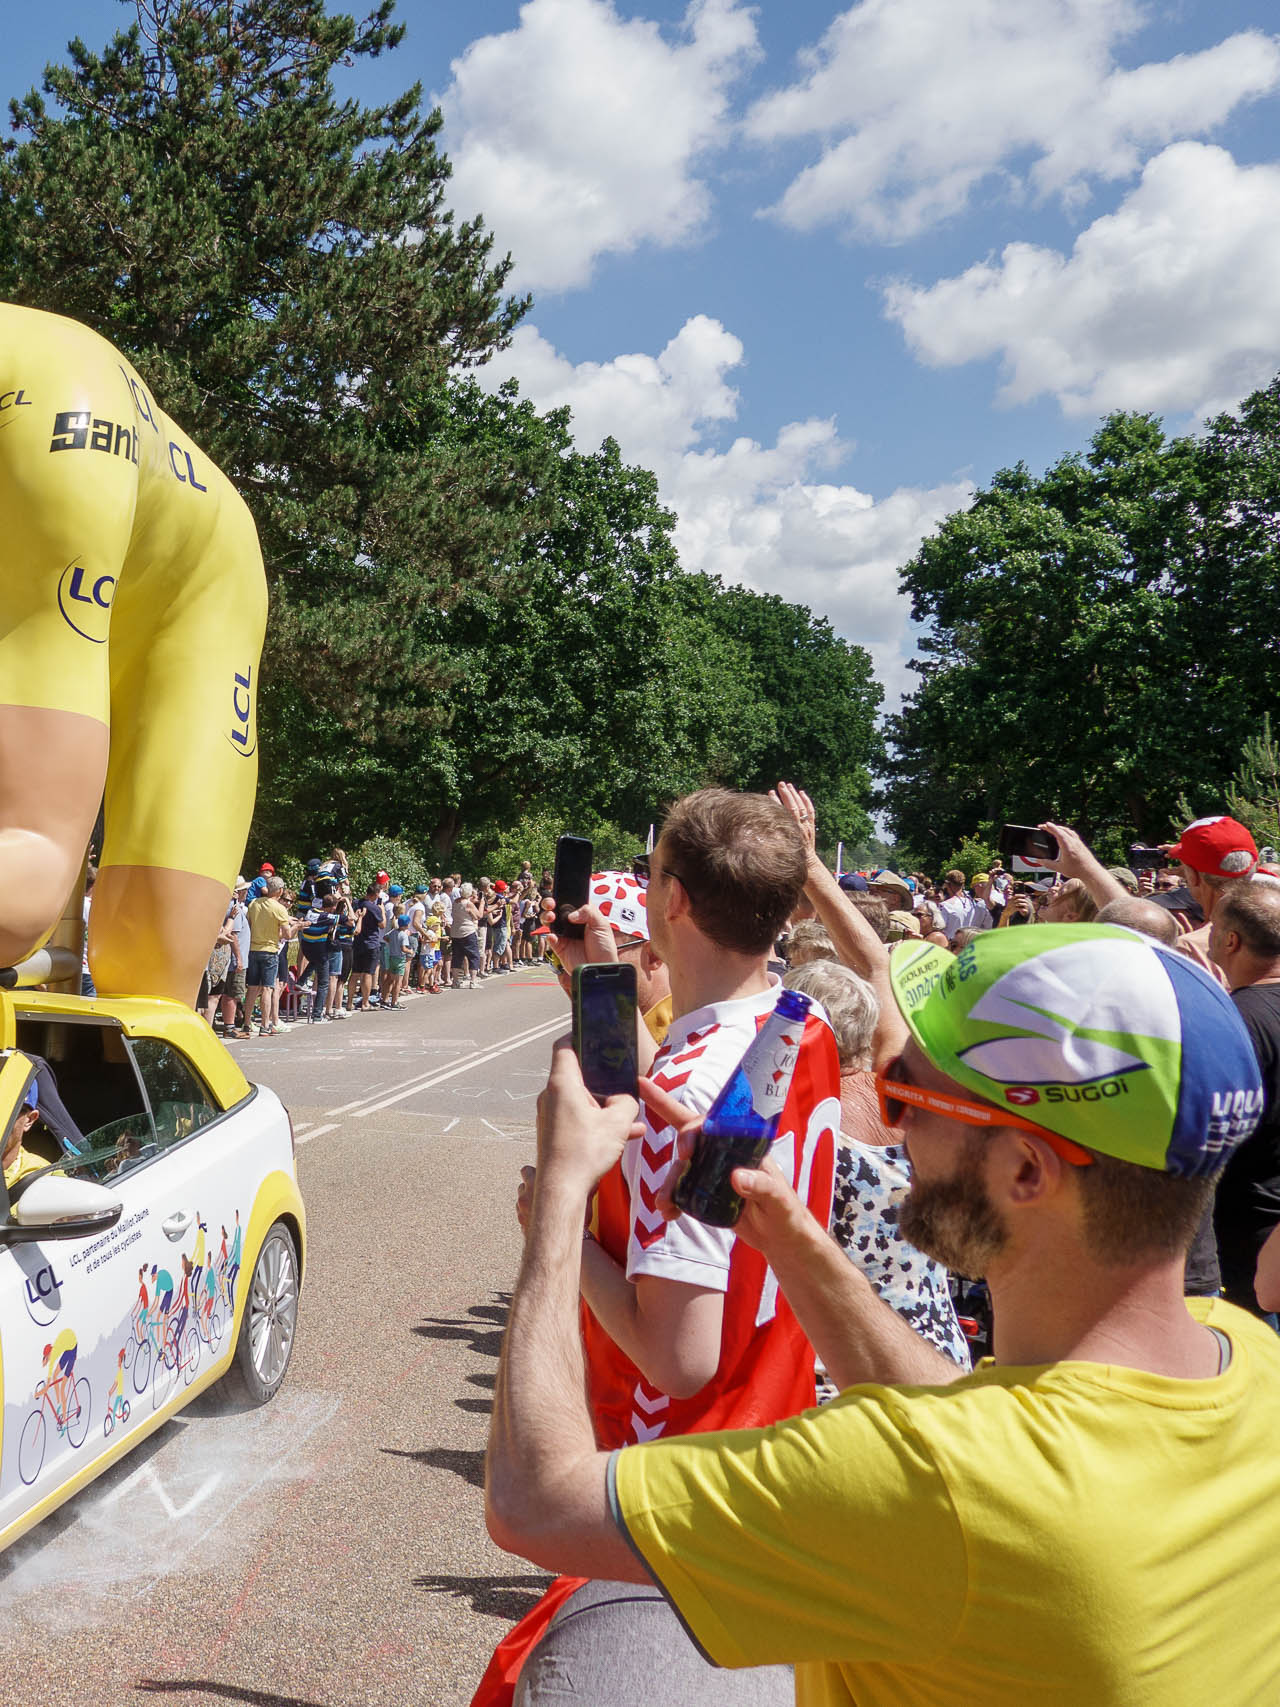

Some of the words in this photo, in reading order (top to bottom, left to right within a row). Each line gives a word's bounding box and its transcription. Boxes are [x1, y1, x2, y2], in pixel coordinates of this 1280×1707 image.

[69, 566, 118, 609] LC
[231, 664, 252, 747] LCL
[82, 1235, 111, 1261] partenaire
[118, 1217, 135, 1235] Maillot
[134, 1208, 150, 1223] Jaune
[100, 1250, 113, 1264] tous
[25, 1264, 64, 1304] LCL
